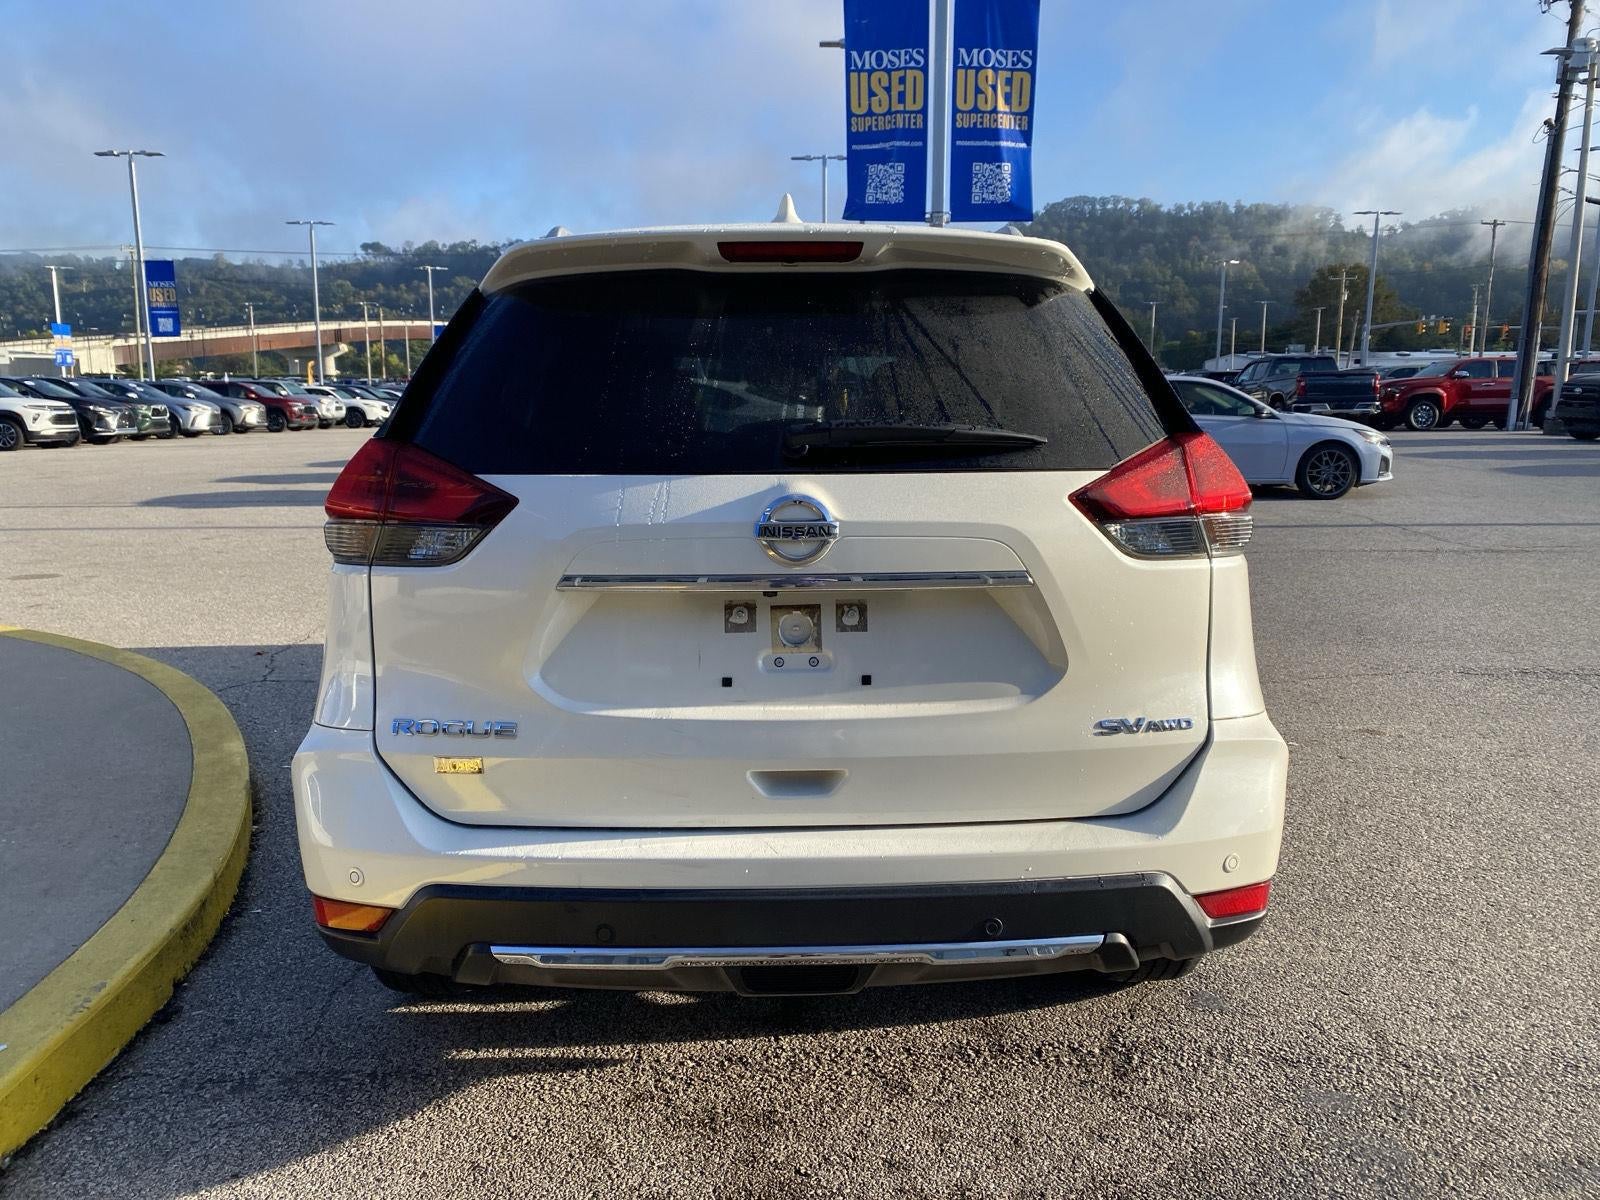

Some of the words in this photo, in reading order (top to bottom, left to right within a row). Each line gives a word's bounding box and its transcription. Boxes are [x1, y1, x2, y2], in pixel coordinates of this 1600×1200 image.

[850, 48, 925, 69] MOSES
[958, 48, 1033, 68] MOSES
[850, 70, 924, 114] USED
[956, 69, 1031, 112] USED
[851, 114, 923, 132] SUPERCENTER
[956, 112, 1029, 130] SUPERCENTER
[149, 288, 176, 302] USED
[762, 525, 831, 538] NISSAN
[391, 718, 518, 737] ROGUE
